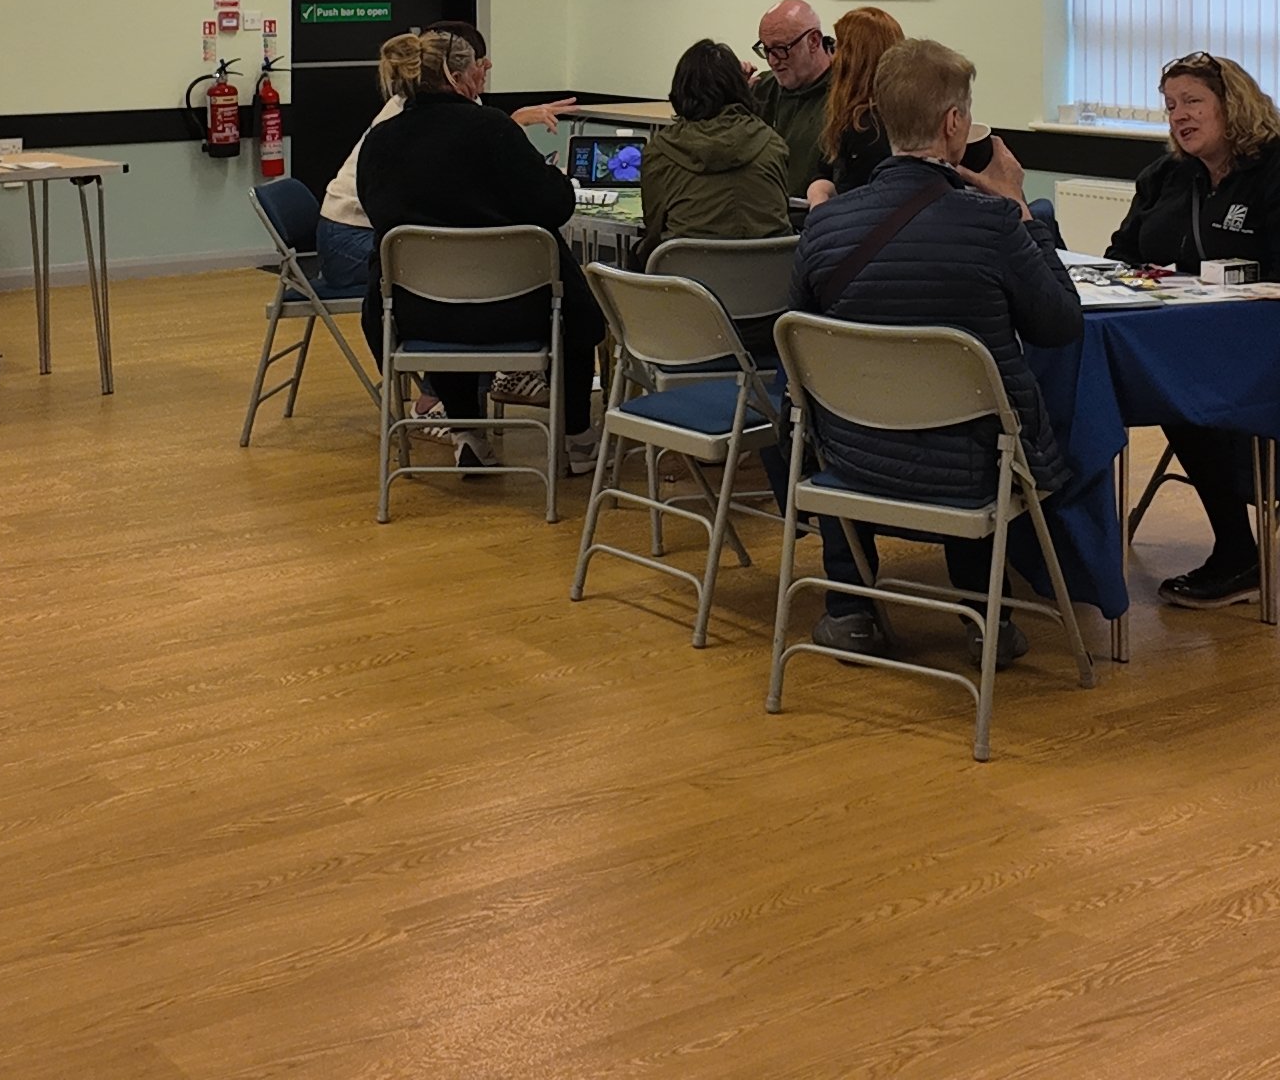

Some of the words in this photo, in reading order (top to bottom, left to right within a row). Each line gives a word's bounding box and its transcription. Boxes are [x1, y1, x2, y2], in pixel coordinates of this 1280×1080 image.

[316, 7, 339, 17] Push
[340, 7, 355, 17] bar
[356, 7, 366, 17] to
[366, 7, 389, 18] open
